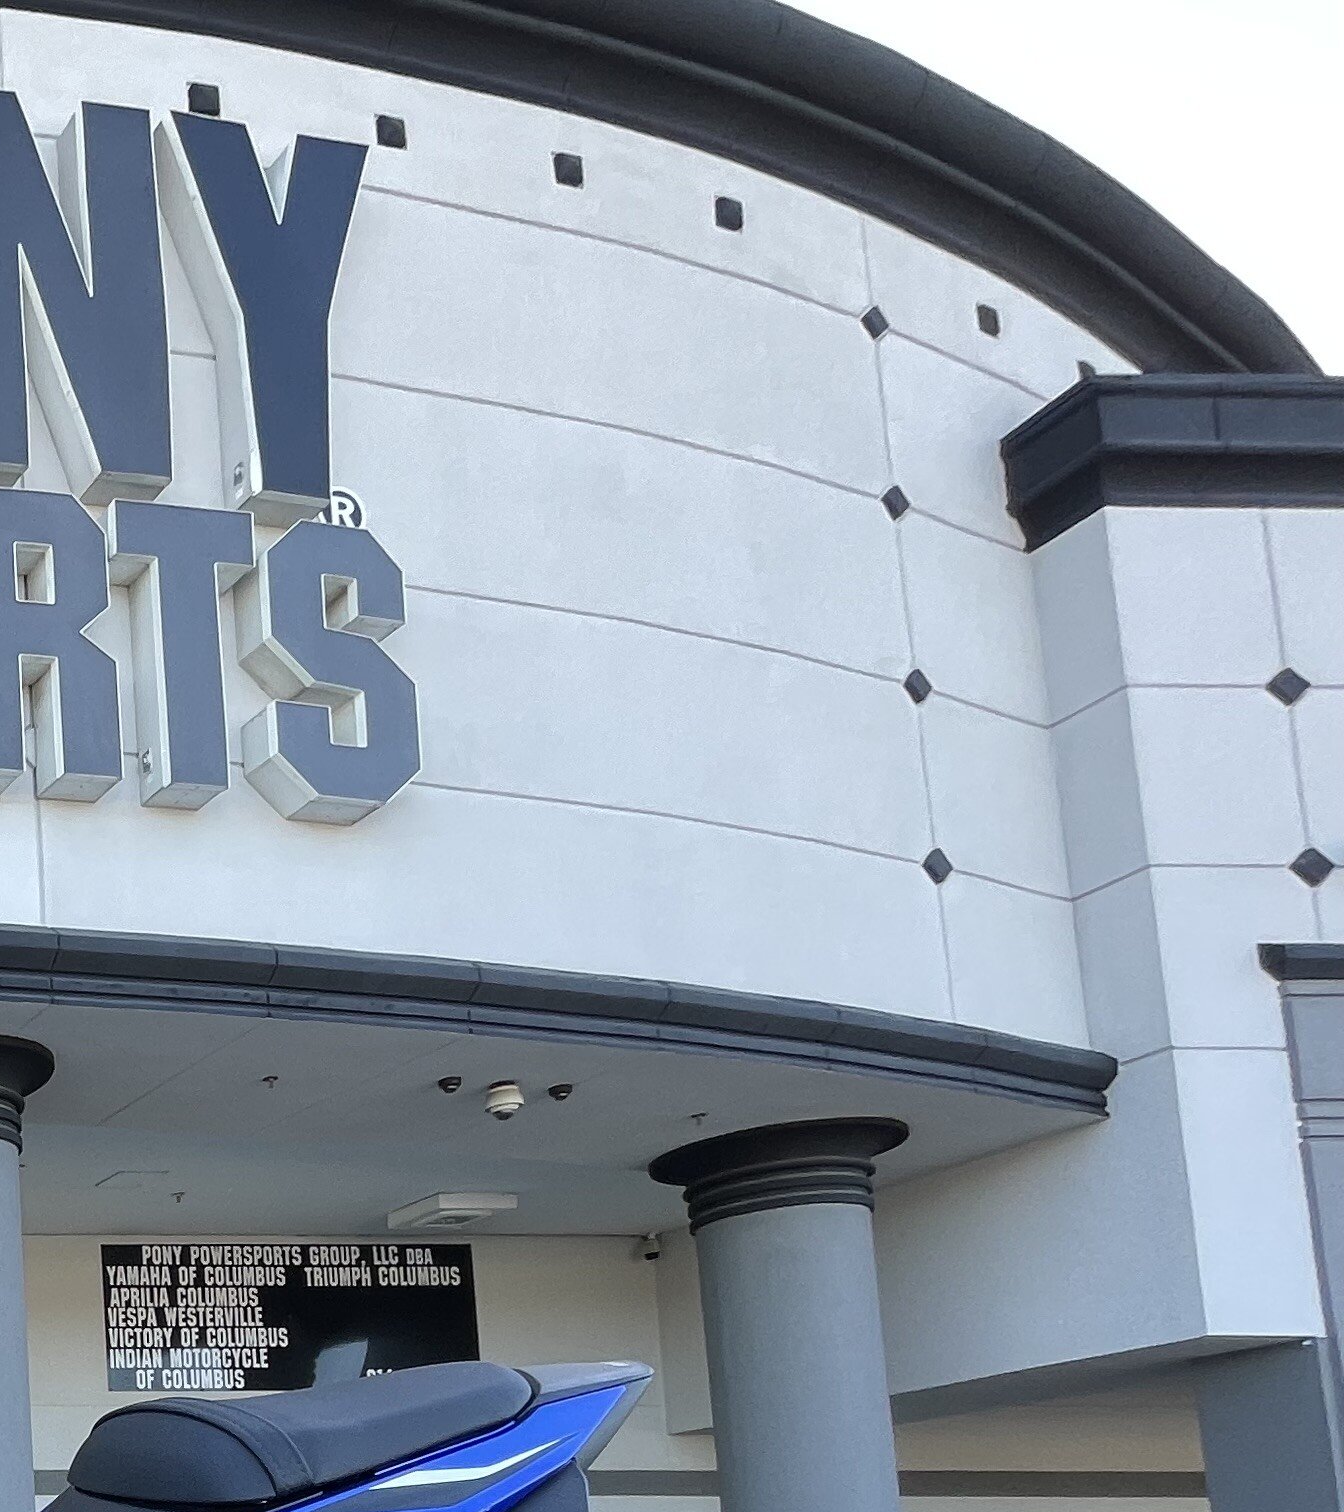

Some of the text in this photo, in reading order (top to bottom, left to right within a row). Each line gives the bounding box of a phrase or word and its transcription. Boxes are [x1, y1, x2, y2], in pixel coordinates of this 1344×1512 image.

[141, 1245, 433, 1268] PONY POWERSPORTS GROUP, LLC DBA
[106, 1265, 286, 1286] YAMAHA OF COLUMBUS
[304, 1266, 461, 1287] TRIUMPH COLUMBUS
[111, 1287, 260, 1307] APRILIA COLUMBUS
[107, 1306, 264, 1327] VESPA WESTERVILLE
[108, 1327, 289, 1348] VICTORY OF COLUMBUS
[109, 1348, 269, 1369] INDIAN MOTORCYCLE
[136, 1369, 245, 1389] OF COLUMBUS
